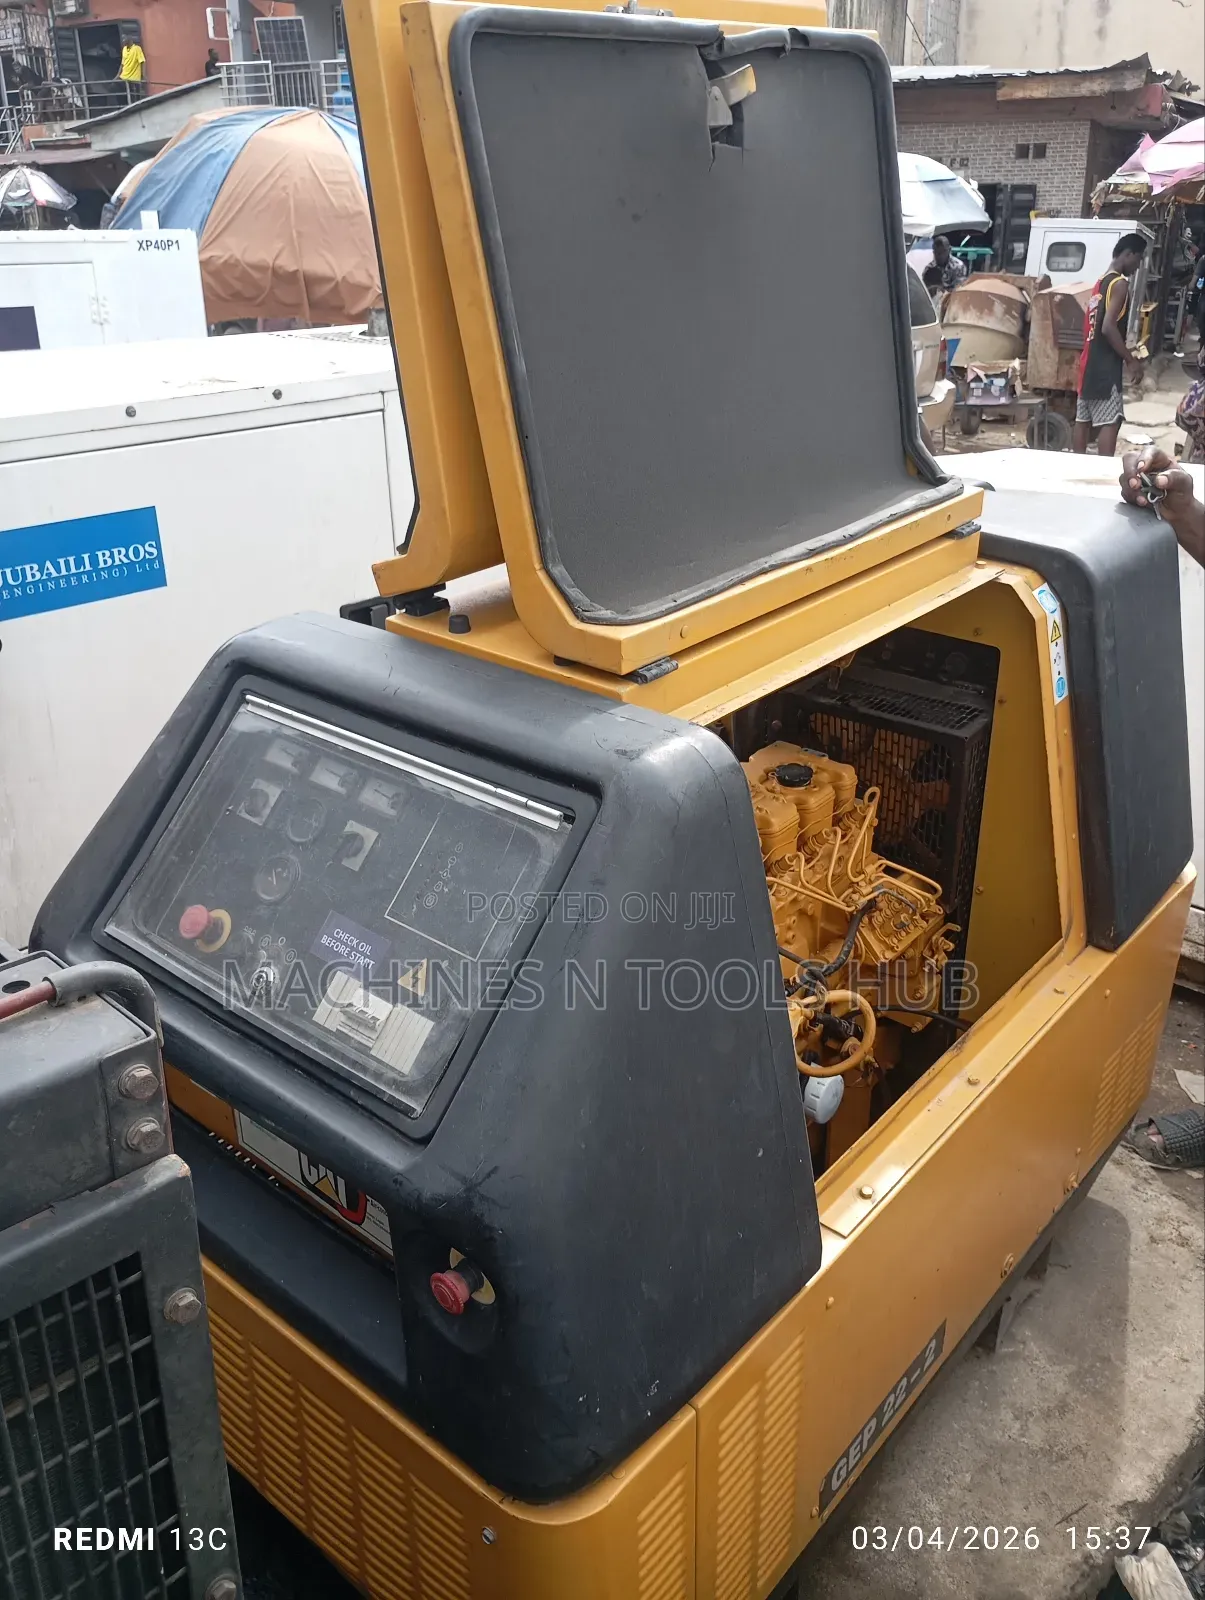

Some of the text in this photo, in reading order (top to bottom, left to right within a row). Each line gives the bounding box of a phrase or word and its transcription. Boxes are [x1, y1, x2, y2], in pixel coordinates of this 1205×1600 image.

[136, 239, 180, 252] XP40P1
[95, 540, 159, 569] BROS
[0, 560, 160, 601] ENGINEERING) Ltd
[320, 934, 376, 970] BEFORE START
[333, 928, 372, 956] CHECK OIL
[831, 1417, 877, 1492] GEP
